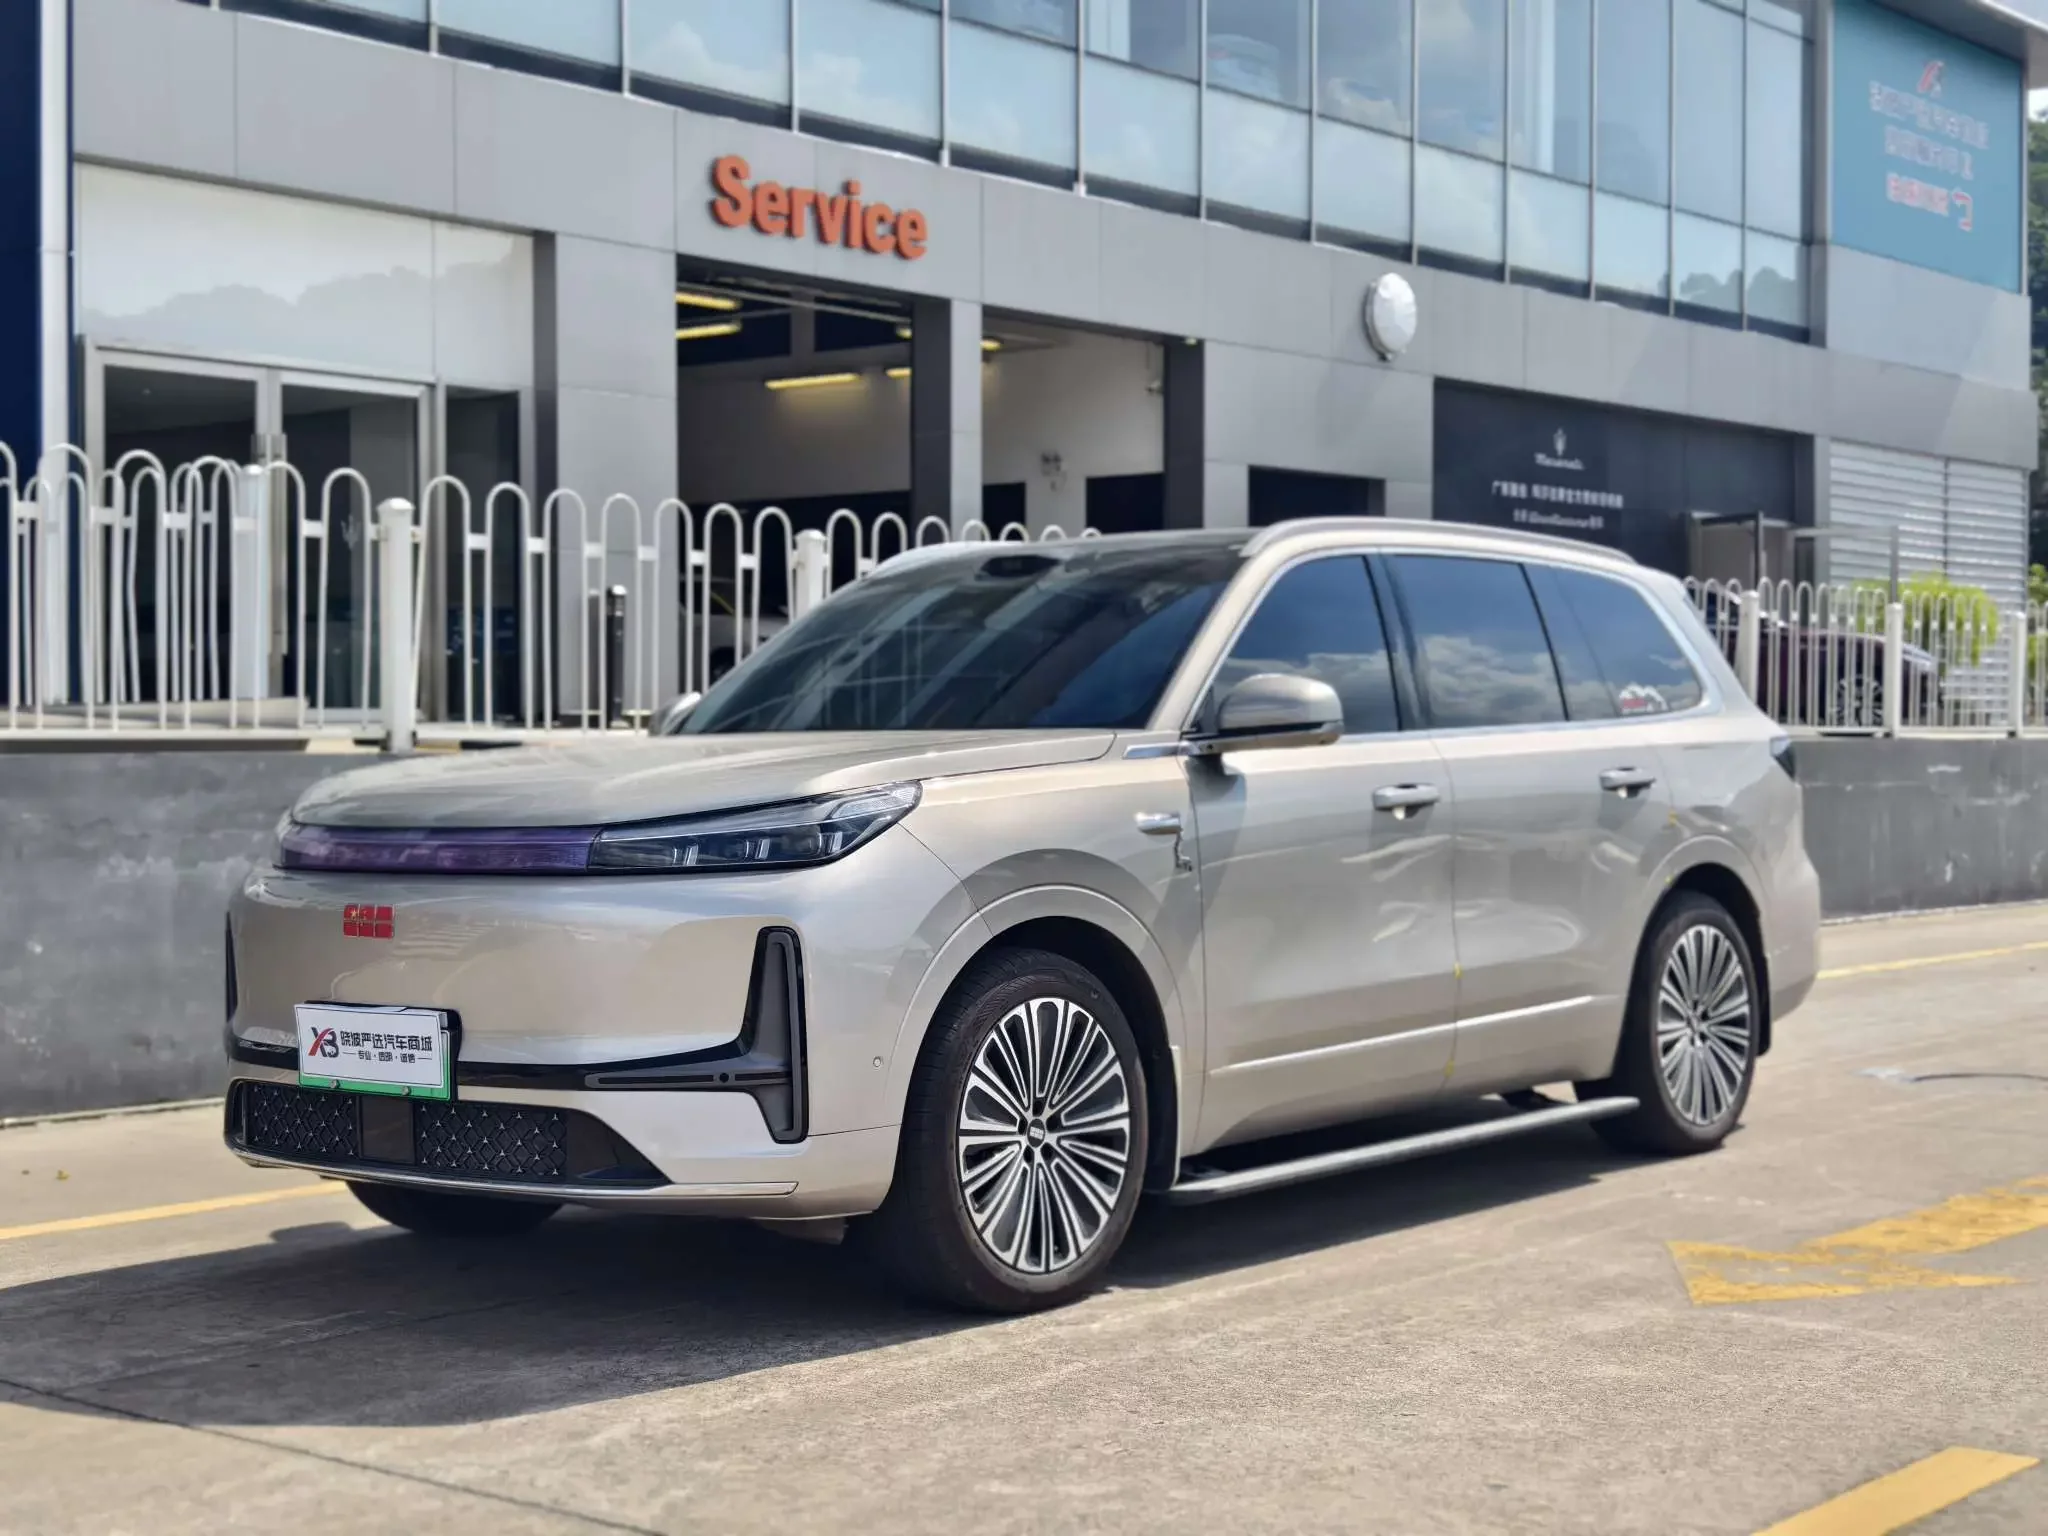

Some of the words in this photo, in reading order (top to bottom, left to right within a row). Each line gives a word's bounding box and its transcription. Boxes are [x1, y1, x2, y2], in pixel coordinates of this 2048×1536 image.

[710, 155, 928, 260] Service
[340, 1030, 433, 1052] 晓波严选汽车商城
